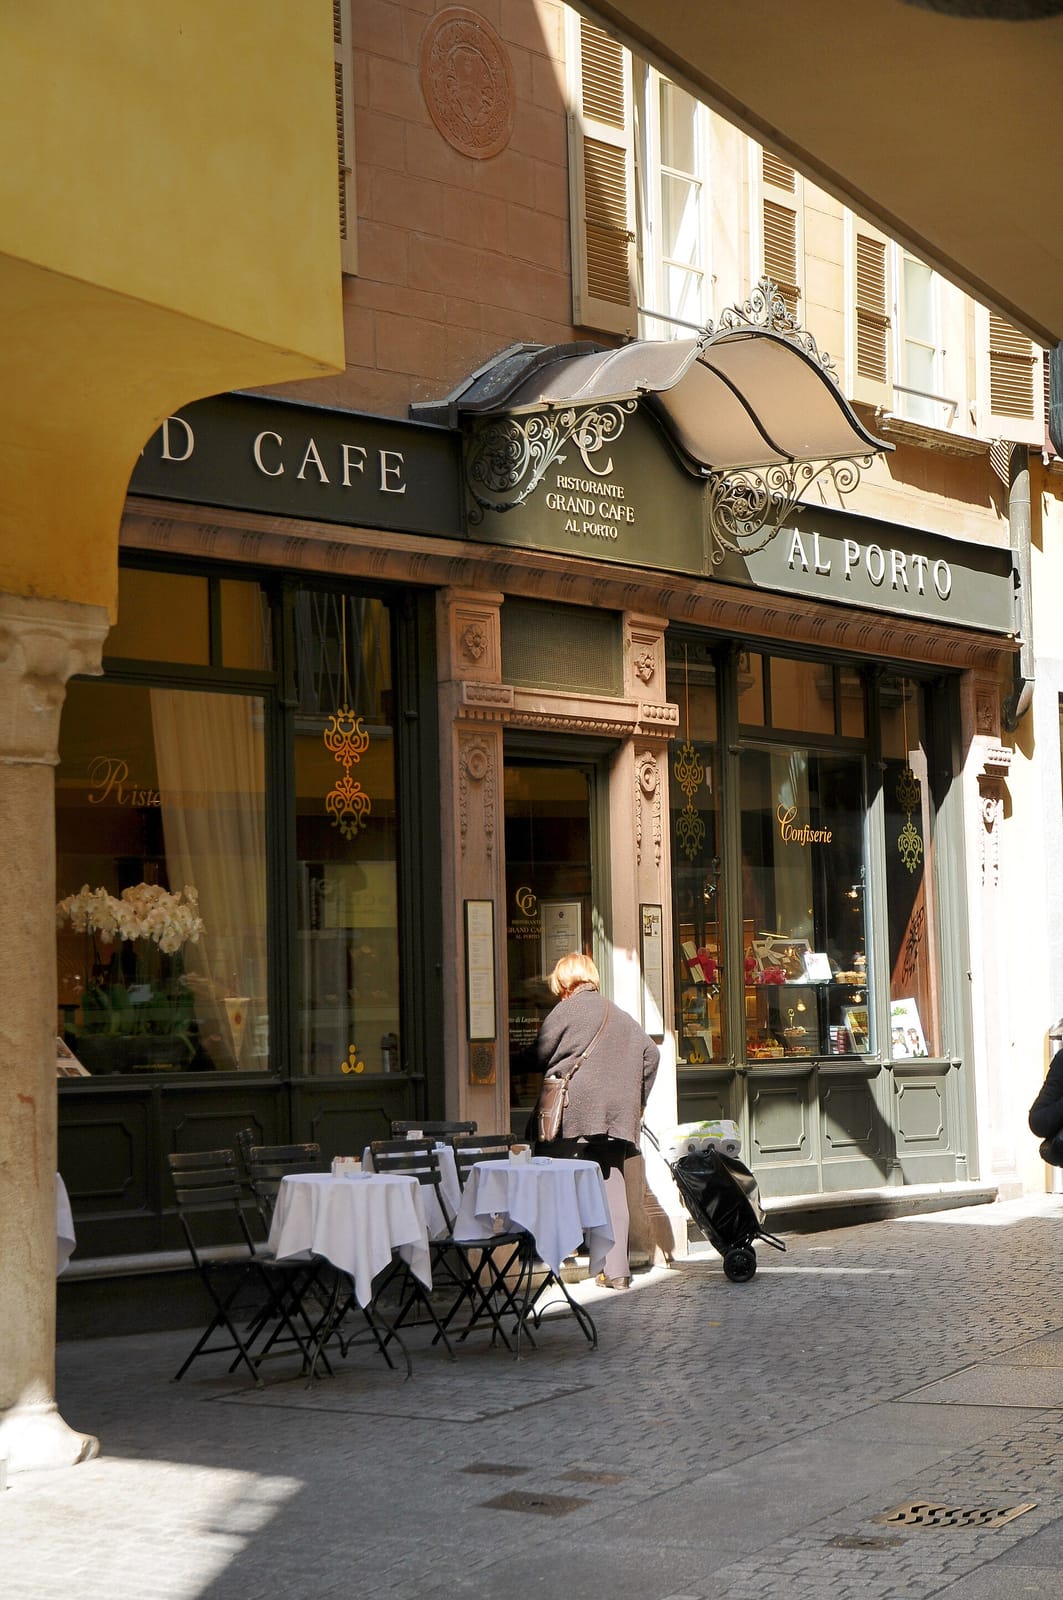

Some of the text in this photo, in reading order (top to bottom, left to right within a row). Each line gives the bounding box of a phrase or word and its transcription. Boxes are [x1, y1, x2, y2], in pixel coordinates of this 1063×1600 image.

[253, 431, 407, 494] CAFE
[556, 475, 625, 499] RISTORANTE
[546, 492, 635, 523] GRAND CAFE
[564, 519, 618, 539] AL PORTO
[788, 527, 952, 595] AL PORTO
[777, 803, 833, 847] Confiserie
